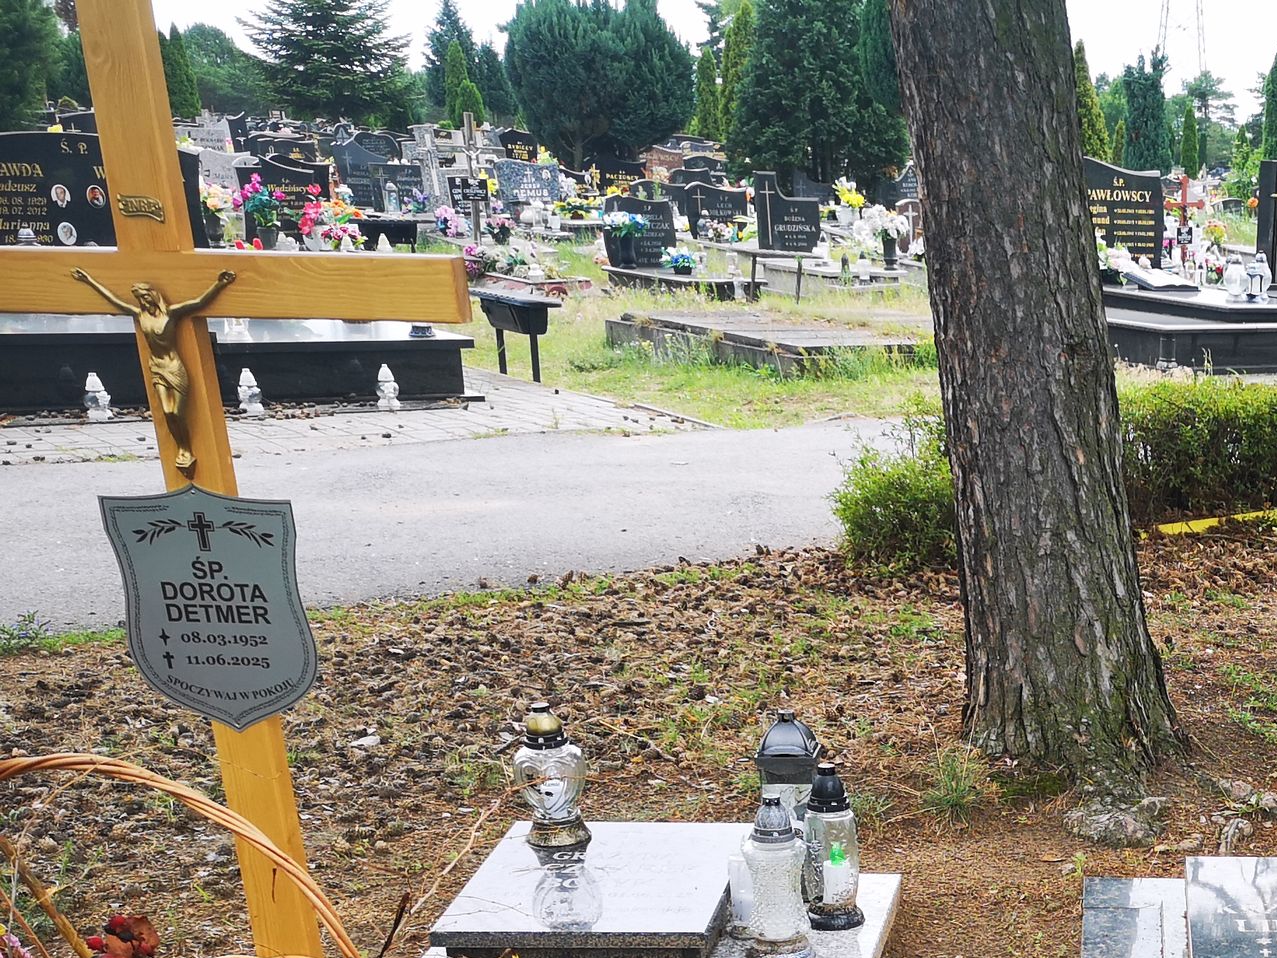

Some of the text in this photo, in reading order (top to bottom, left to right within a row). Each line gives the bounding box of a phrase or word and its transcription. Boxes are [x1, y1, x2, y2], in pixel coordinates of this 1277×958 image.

[774, 223, 816, 232] GRUDZIŃSKA
[191, 556, 228, 580] ŚP.
[160, 581, 269, 603] DOROTA
[165, 603, 272, 625] DETMER
[180, 631, 269, 648] 08.03.1952
[185, 653, 271, 670] 11.06.2025
[166, 674, 297, 701] SPOCZYWAJ W POKOJU
